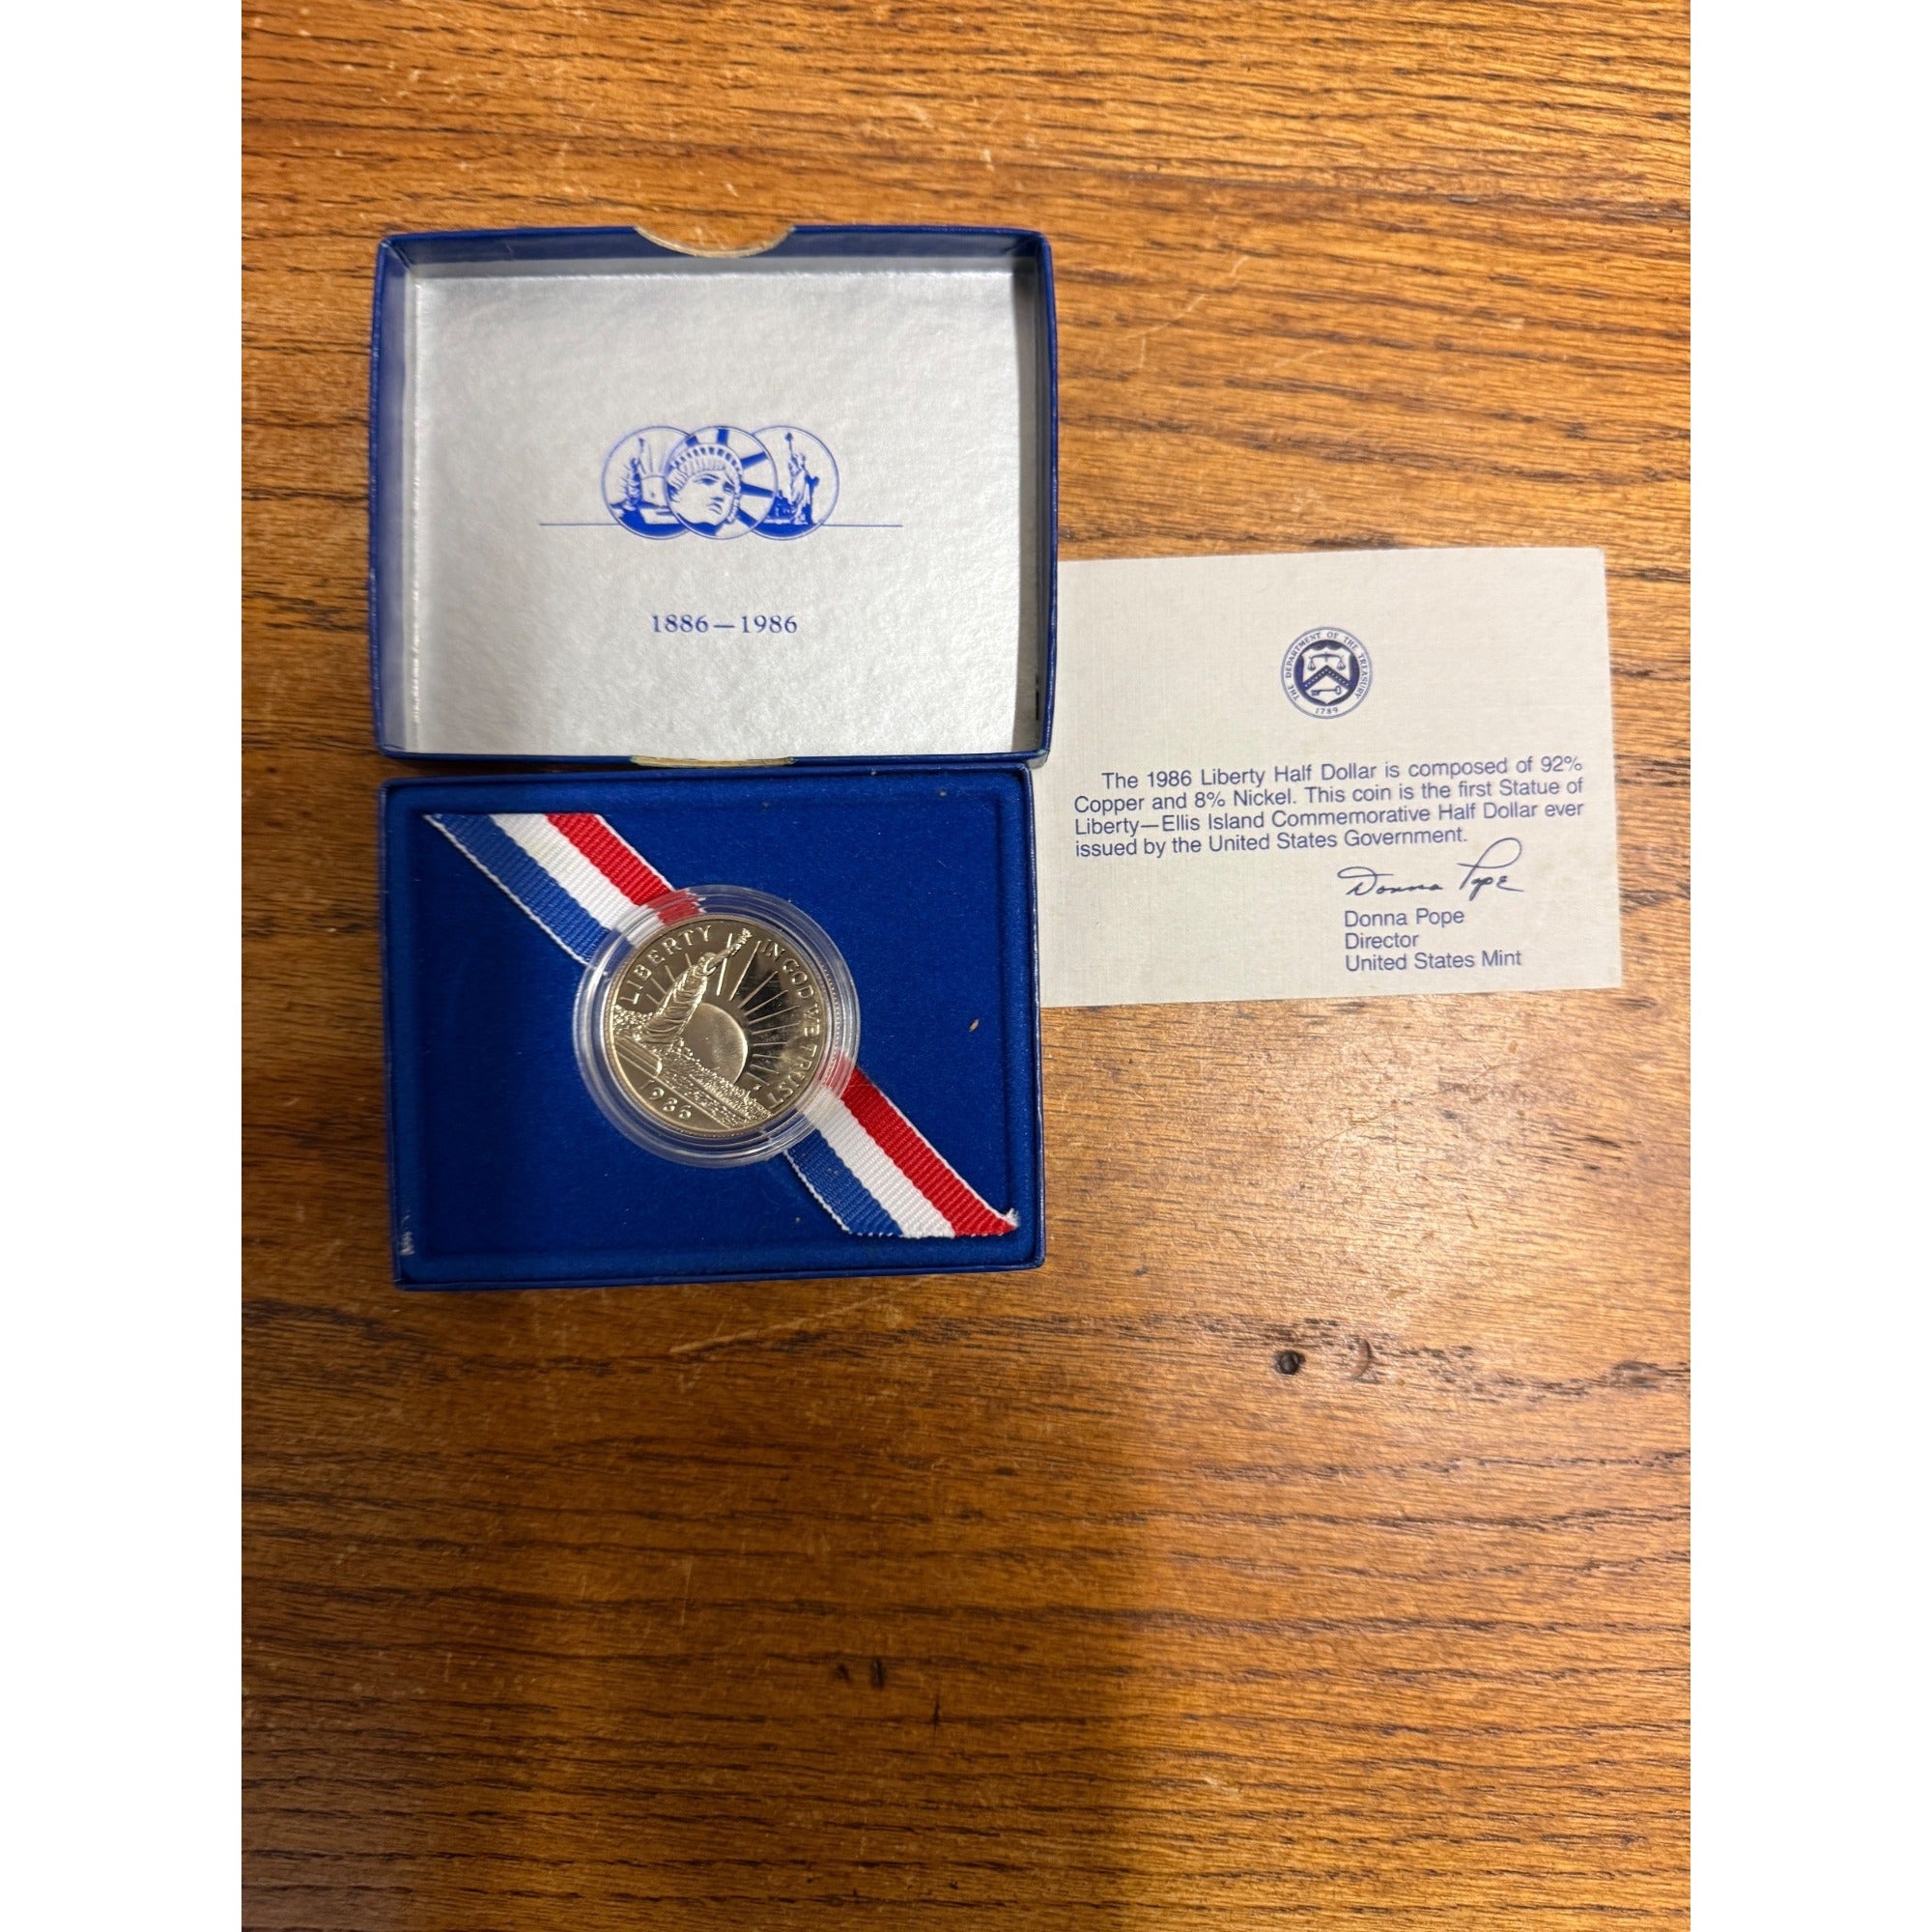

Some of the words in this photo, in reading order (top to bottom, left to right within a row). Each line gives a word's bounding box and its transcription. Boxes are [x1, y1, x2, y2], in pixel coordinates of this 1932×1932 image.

[1101, 773, 1138, 789] The
[1148, 770, 1192, 787] 1986
[1202, 768, 1264, 787] Liberty
[1275, 764, 1312, 782] Half
[1321, 763, 1377, 781] Dollar
[1385, 761, 1400, 778] is
[1408, 757, 1507, 779] composed
[1517, 756, 1532, 773] of
[1541, 755, 1582, 772] 92%
[1074, 796, 1145, 815] Copper
[1152, 792, 1186, 810] and
[1195, 791, 1225, 808] 8%
[1234, 788, 1296, 806] Nickel.
[1304, 786, 1346, 803] This
[1352, 784, 1391, 802] coin
[1400, 783, 1414, 800] is
[1421, 782, 1451, 799] the
[1459, 781, 1492, 797] first
[1500, 779, 1560, 796] Statue
[1567, 777, 1582, 794] of
[1208, 811, 1264, 830] Island
[1271, 806, 1431, 827] Commemorative
[1438, 803, 1475, 820] Half
[1484, 802, 1538, 818] Dollar
[1545, 804, 1584, 817] ever
[1076, 838, 1137, 857] issued
[1144, 838, 1166, 858] by
[1172, 837, 1202, 853] the
[1209, 834, 1269, 852] United
[1277, 832, 1337, 849] States
[1345, 827, 1466, 846] Government.
[1345, 910, 1407, 927] Donna
[1416, 908, 1464, 928] Pope
[761, 939, 784, 962] IN
[1346, 932, 1419, 950] Director
[620, 924, 711, 1005] LIBERTY
[1346, 953, 1406, 972] United
[1414, 952, 1475, 969] States
[1482, 950, 1521, 966] Mint
[782, 958, 814, 999] GOD
[804, 1006, 820, 1037] WE
[768, 1044, 818, 1109] TRUST
[640, 1079, 692, 1121] 1986
